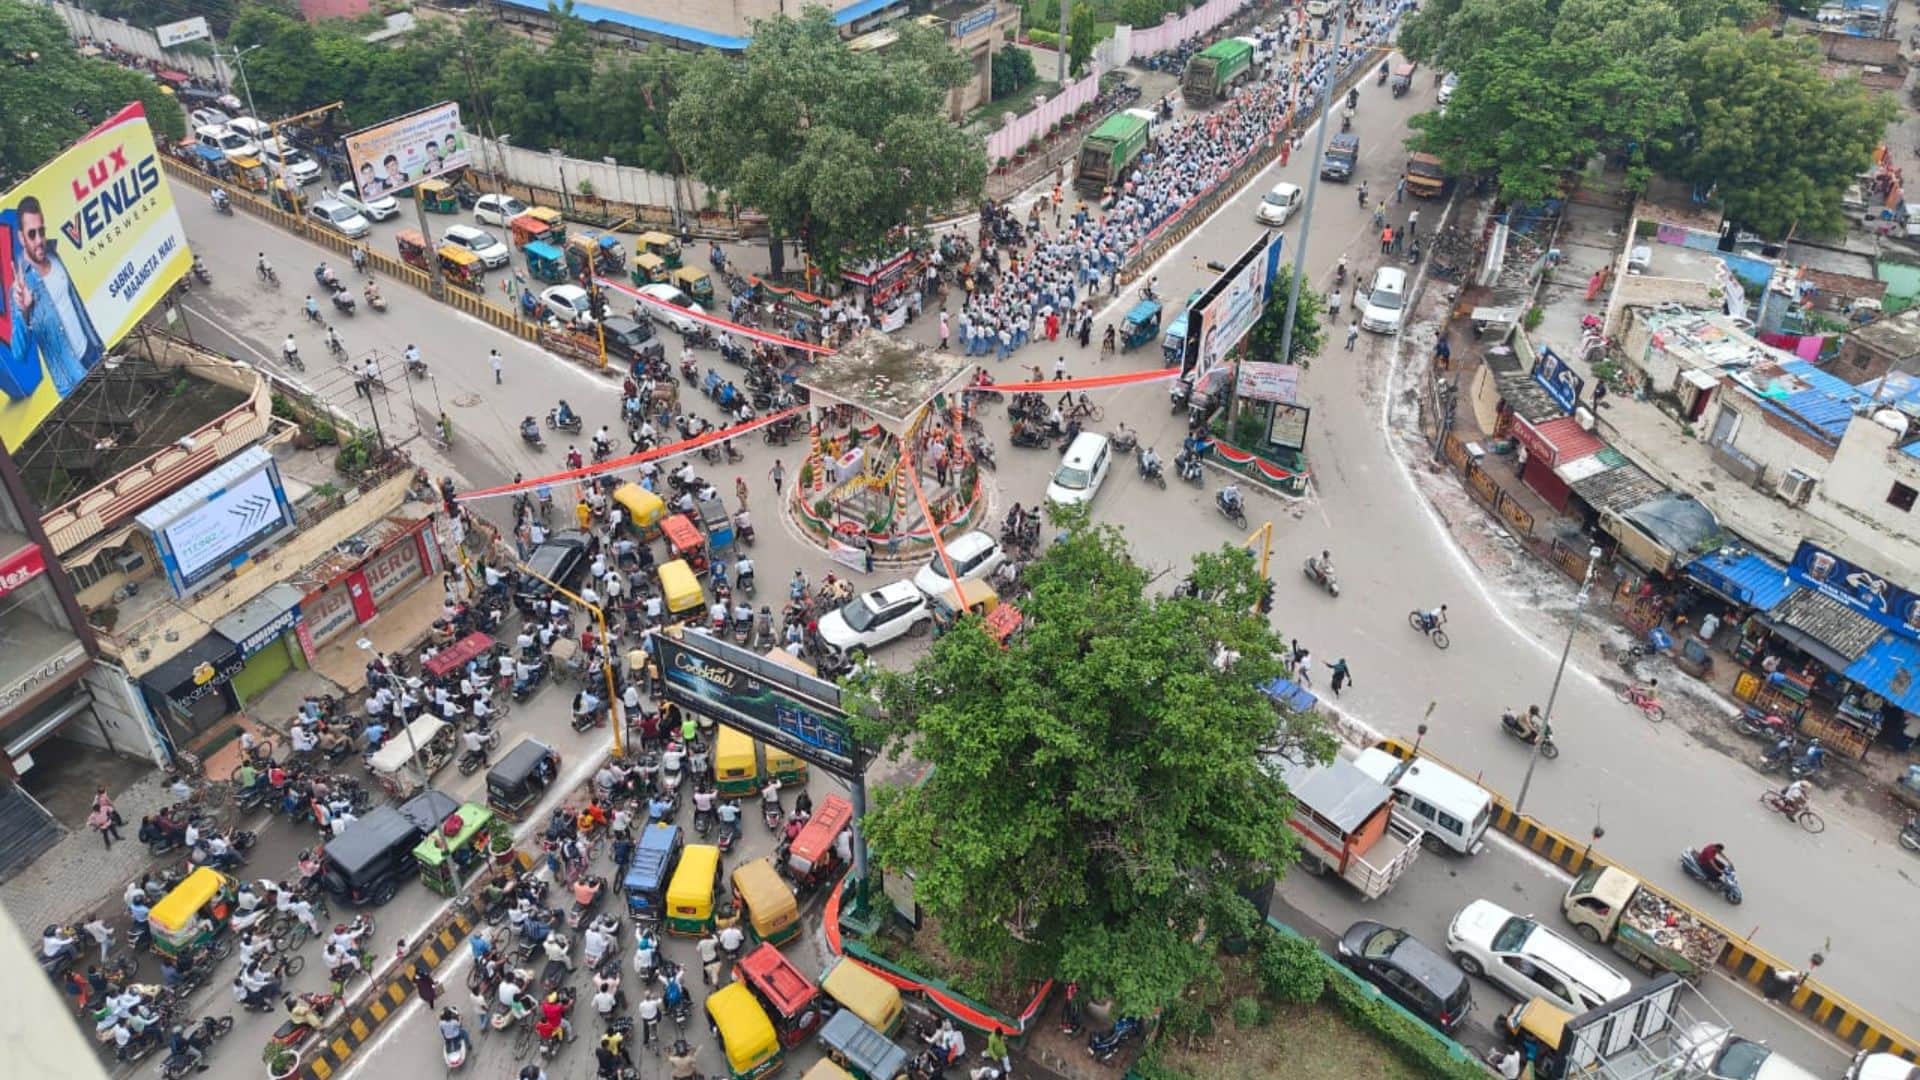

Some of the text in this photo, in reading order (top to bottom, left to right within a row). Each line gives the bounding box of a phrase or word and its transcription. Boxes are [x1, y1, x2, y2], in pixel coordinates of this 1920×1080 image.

[72, 145, 128, 201] LUX
[61, 154, 159, 249] VENUS
[83, 198, 156, 264] INNERWEAR
[109, 261, 135, 298] SABKO
[366, 545, 413, 587] HERO
[242, 611, 293, 652] LUMINOUS
